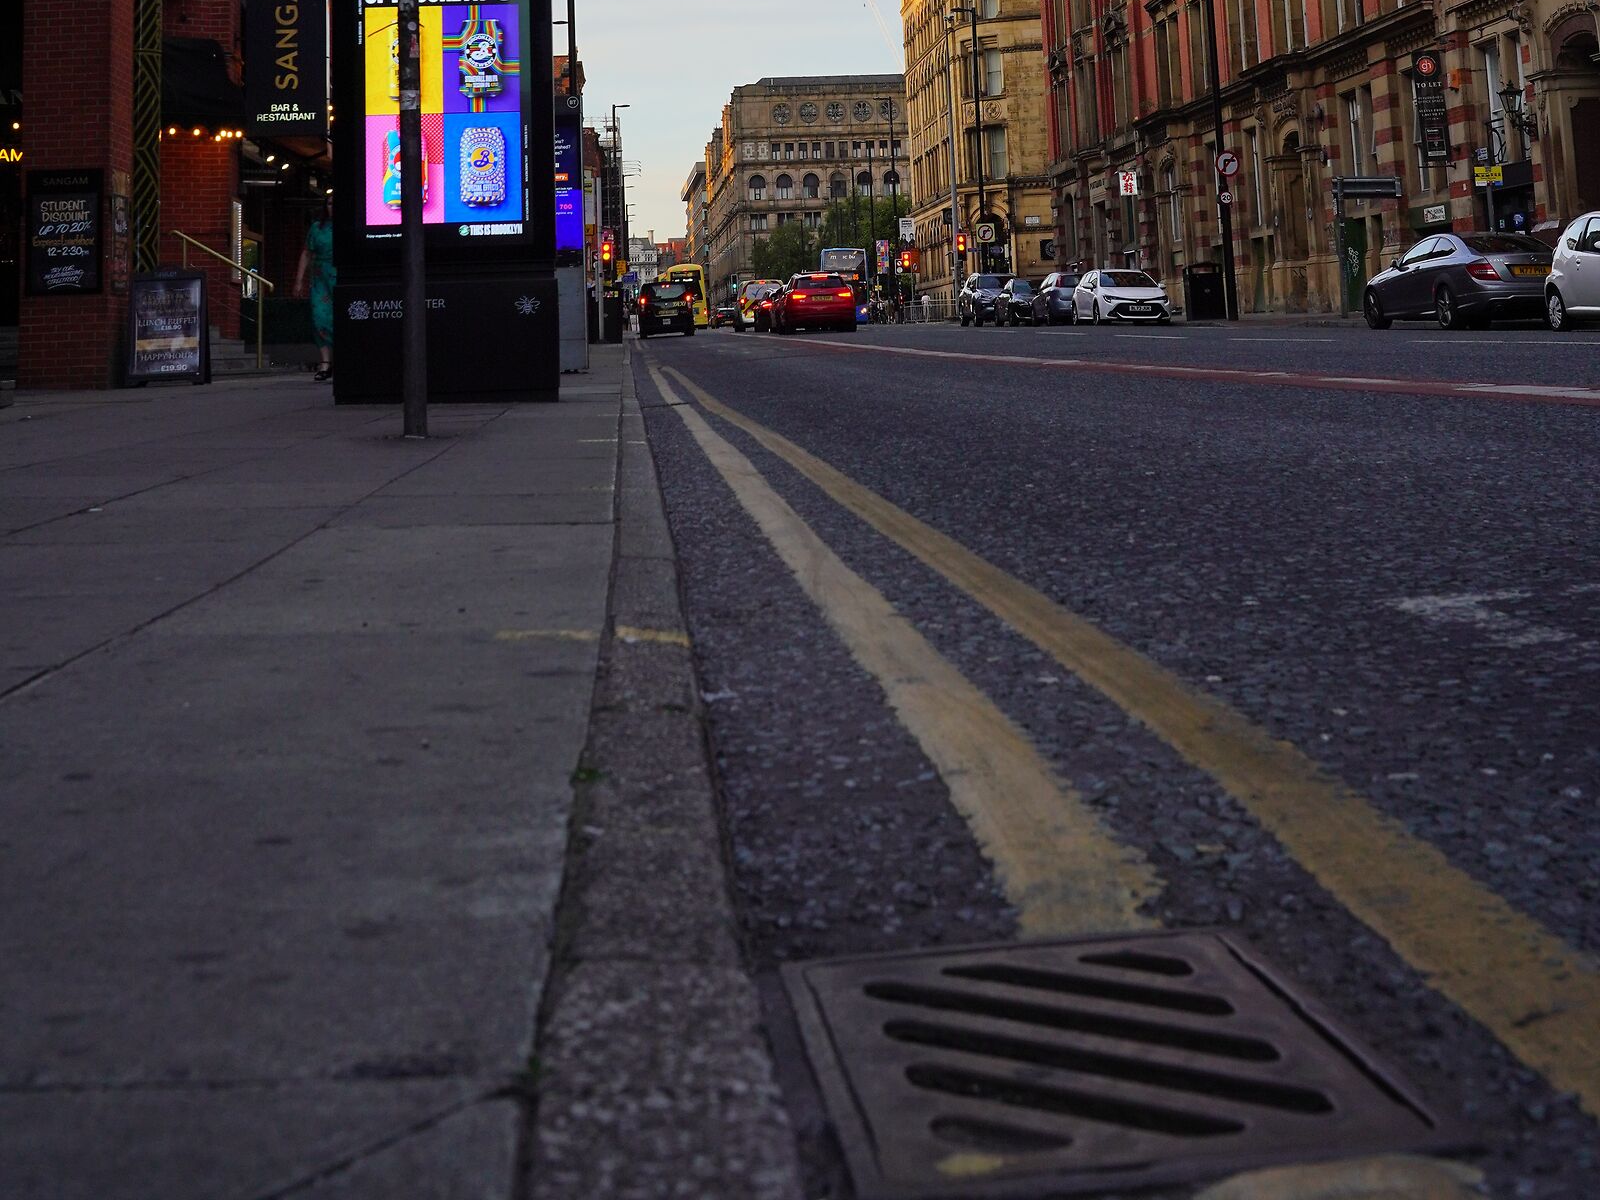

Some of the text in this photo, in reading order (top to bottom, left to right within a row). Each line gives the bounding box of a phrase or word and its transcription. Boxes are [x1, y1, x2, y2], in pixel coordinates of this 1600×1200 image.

[271, 104, 290, 112] BAR
[256, 112, 316, 122] RESTAURANT
[42, 177, 88, 186] SANGAM
[40, 200, 86, 212] STUDENT
[42, 211, 90, 223] DISCOUNT
[39, 221, 92, 236] UP TO 20%
[469, 223, 523, 236] THIS IS BROOKLYN
[372, 311, 389, 319] CITY
[141, 351, 194, 361] HAPPY HOUR
